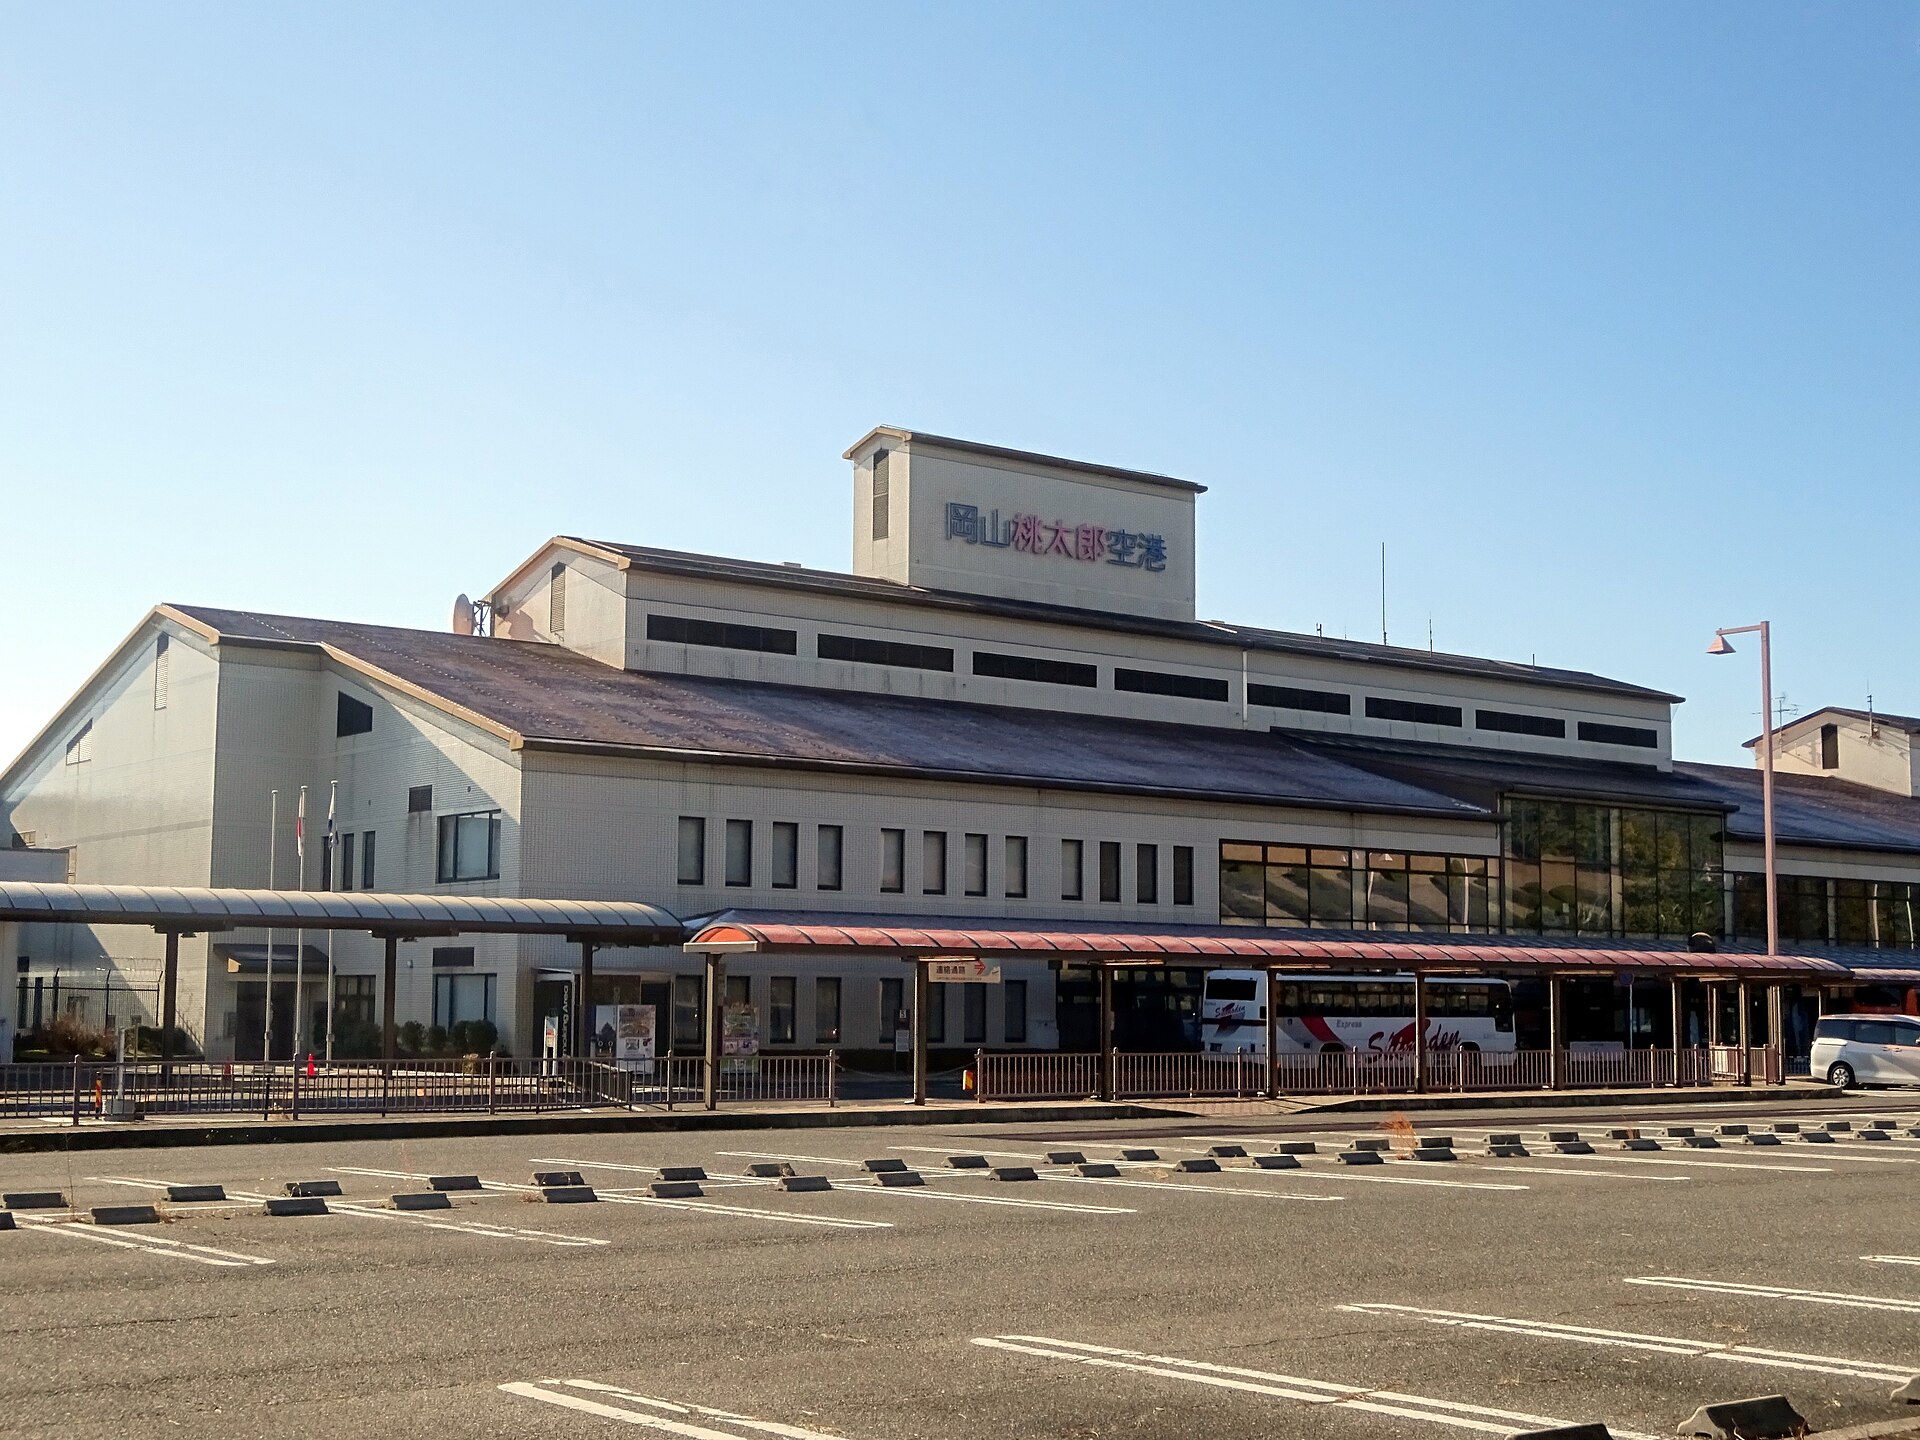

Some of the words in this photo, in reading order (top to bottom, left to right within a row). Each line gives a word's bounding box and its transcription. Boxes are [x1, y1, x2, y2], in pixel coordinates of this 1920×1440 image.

[945, 502, 1167, 572] 岡山桃太郎空港
[1336, 1019, 1362, 1030] Express
[1368, 1023, 1462, 1062] Shimden
